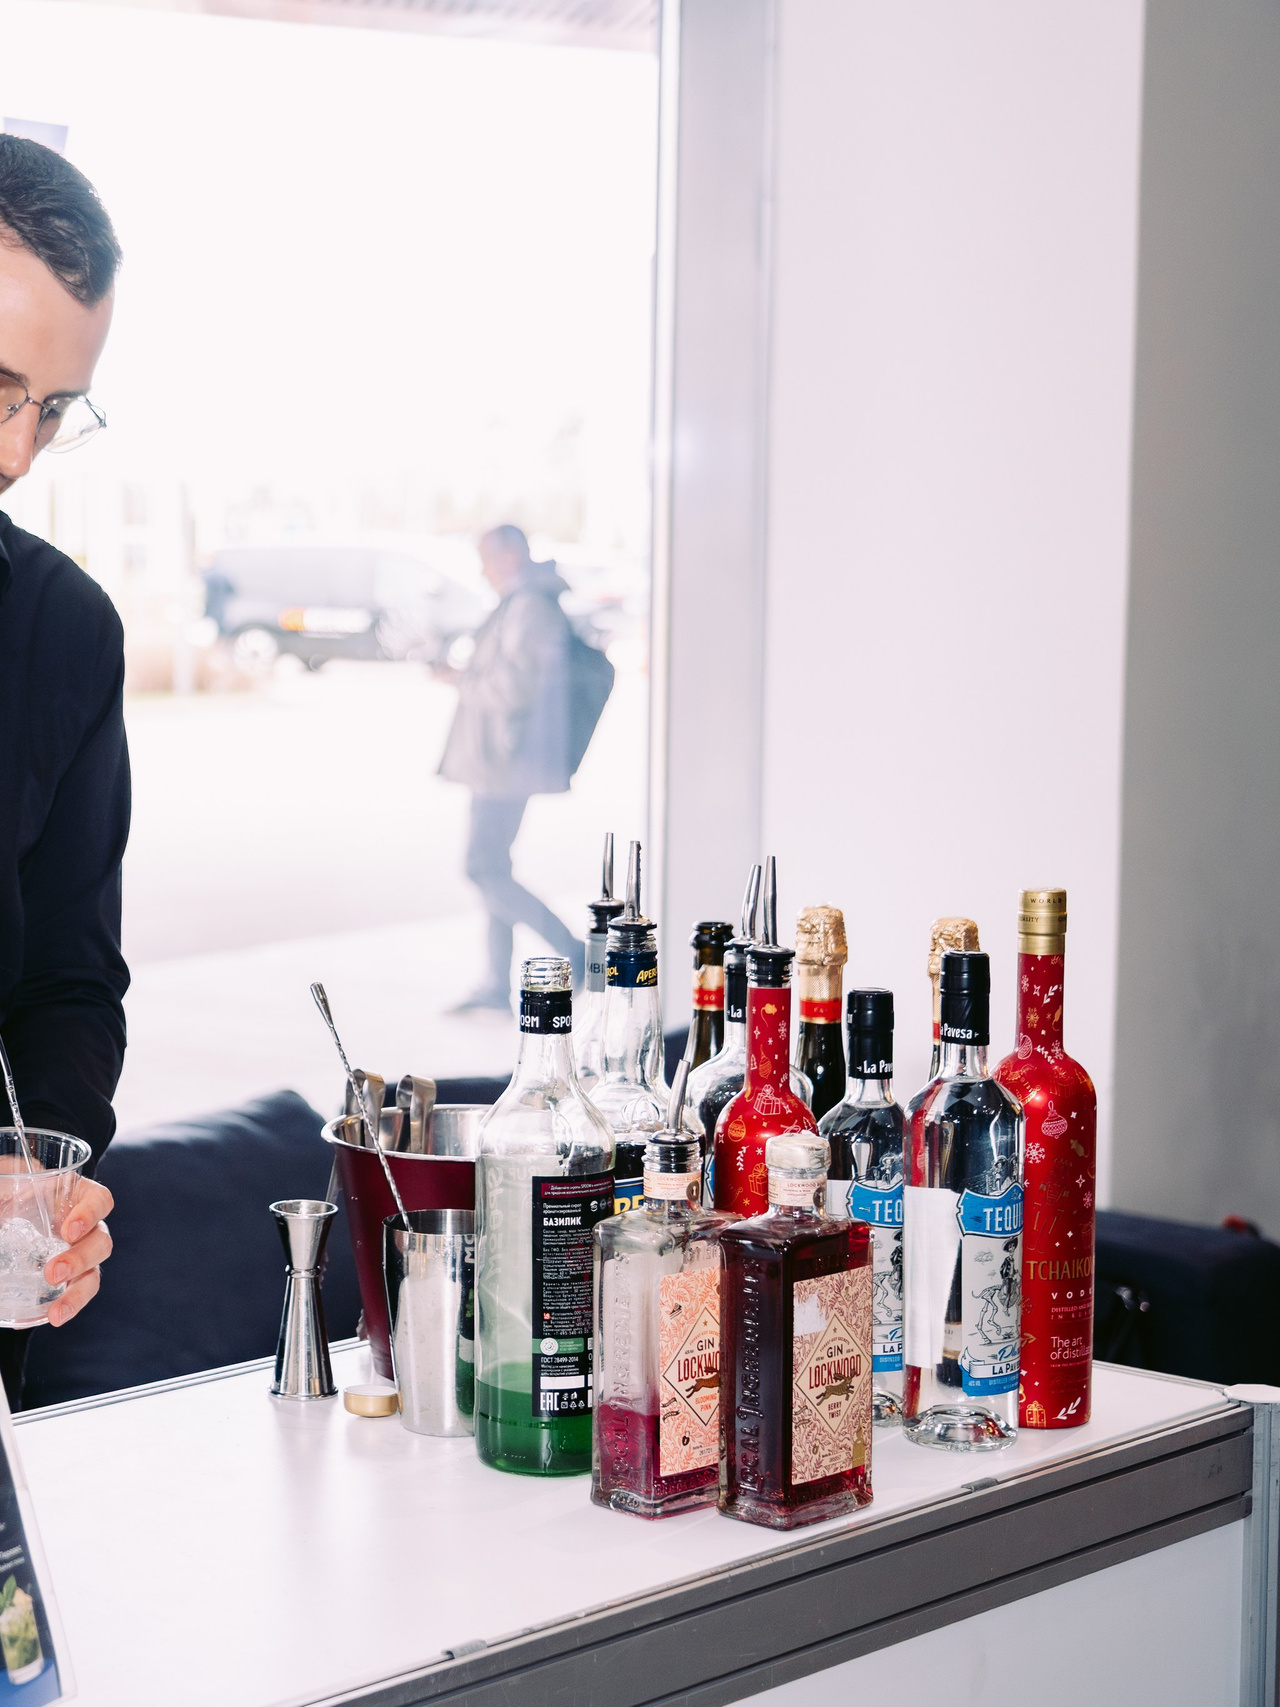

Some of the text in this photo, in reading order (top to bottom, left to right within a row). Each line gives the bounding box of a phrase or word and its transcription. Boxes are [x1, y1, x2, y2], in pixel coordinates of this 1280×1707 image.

[731, 1005, 742, 1018] La
[944, 1022, 973, 1039] Pavesa
[864, 1060, 877, 1074] La
[543, 1217, 582, 1227] БАЗИЛИК
[697, 1337, 715, 1351] GIN
[1051, 1336, 1083, 1349] The art
[827, 1344, 843, 1359] GIN
[883, 1345, 895, 1354] LA
[1050, 1348, 1062, 1360] of
[809, 1354, 862, 1390] LOCKWOOD
[992, 1366, 1004, 1376] LA
[695, 1393, 718, 1405] BLOOMING
[701, 1404, 712, 1412] PINK
[828, 1401, 842, 1411] BERRY
[829, 1410, 842, 1420] TWIST
